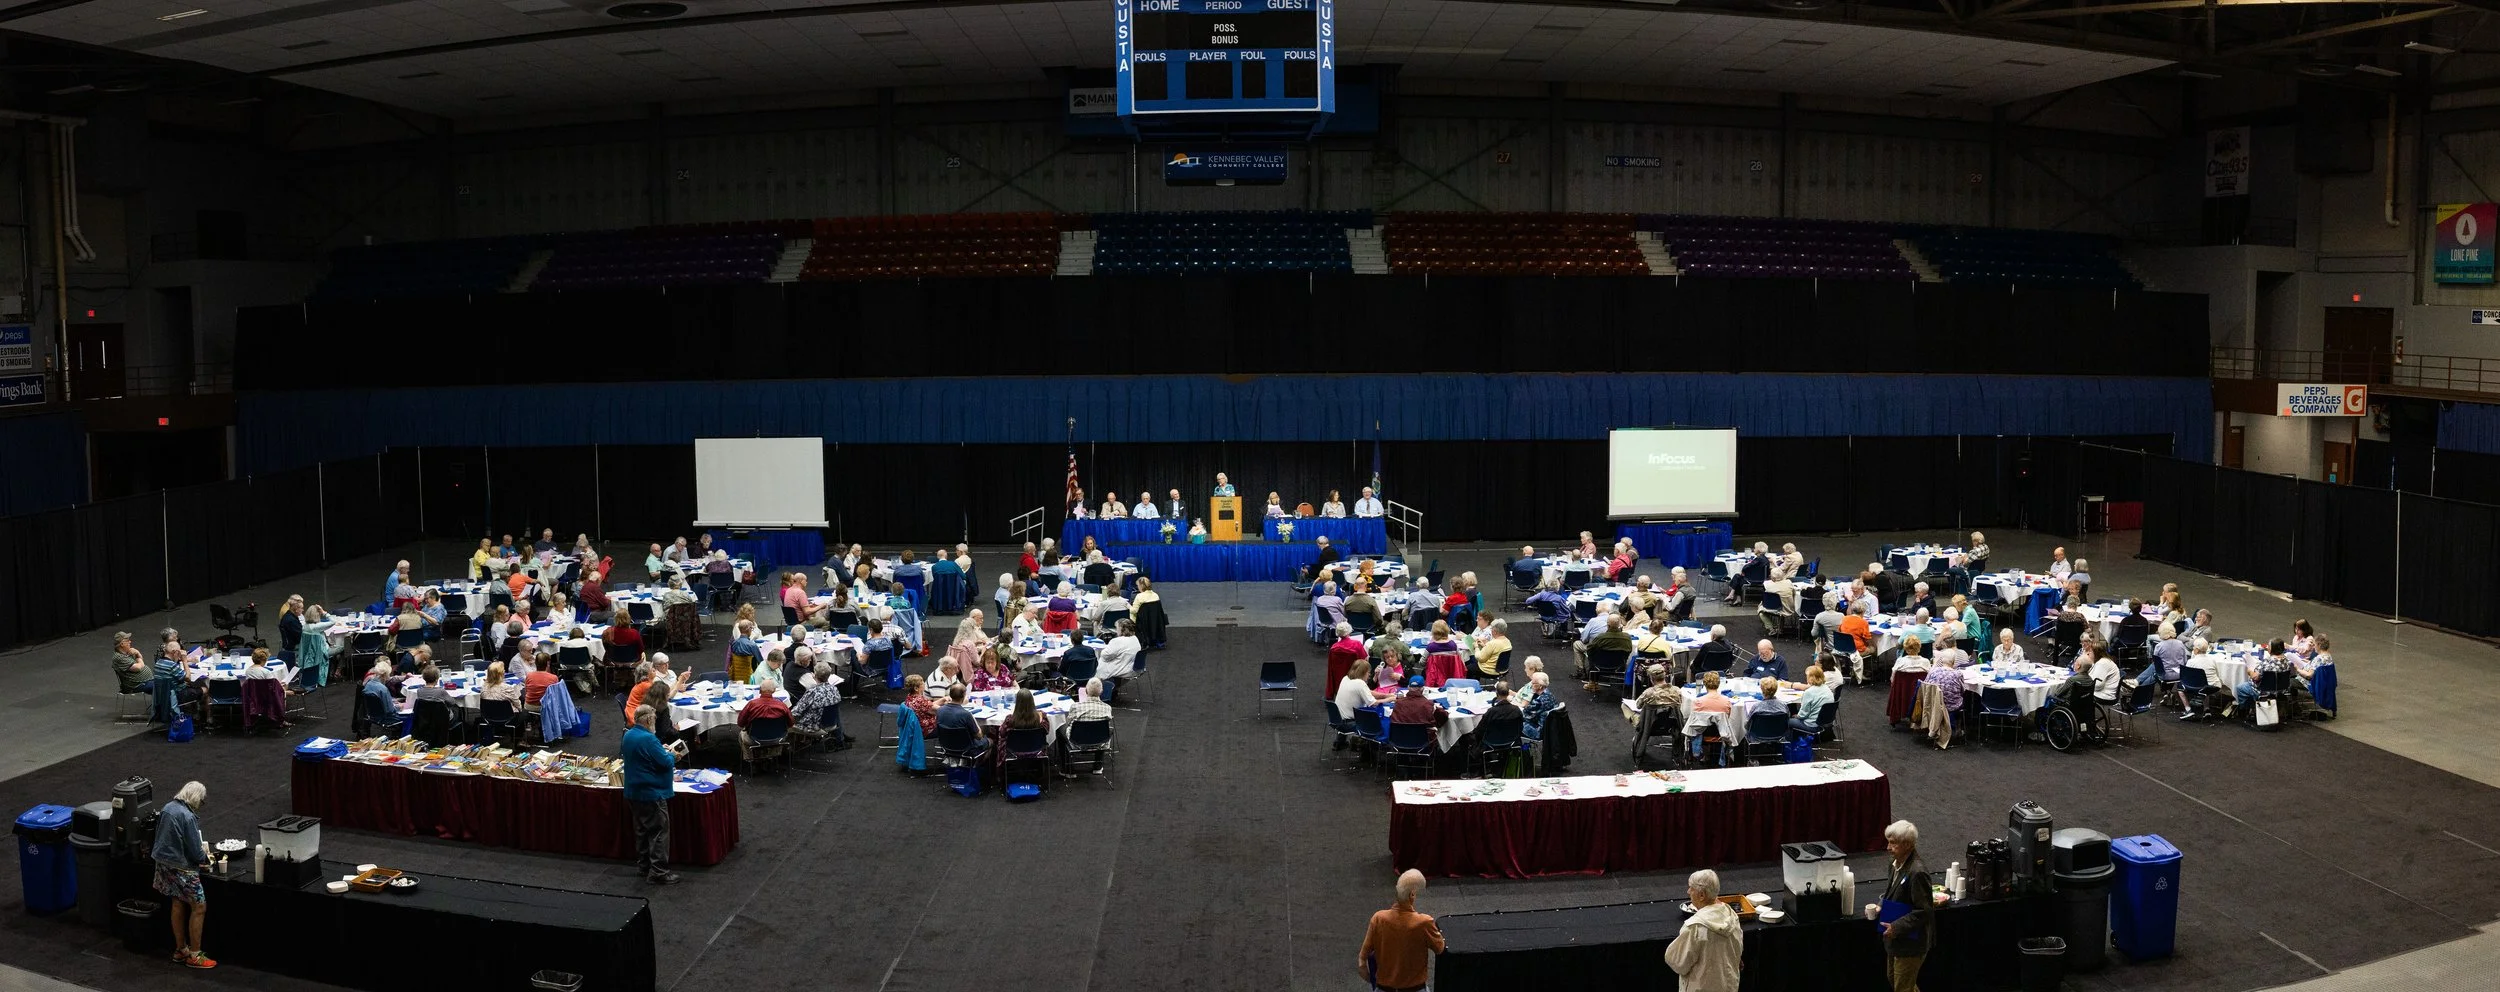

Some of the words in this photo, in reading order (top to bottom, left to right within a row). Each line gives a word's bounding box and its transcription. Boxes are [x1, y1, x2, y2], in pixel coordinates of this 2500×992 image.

[1140, 0, 1180, 11] HOME
[1205, 1, 1242, 10] PERIOD
[1267, 0, 1310, 9] GUEST
[1213, 23, 1238, 32] POSS.
[1211, 35, 1239, 44] BONUS
[1321, 0, 1332, 69] USTA
[1134, 52, 1167, 62] FOULS
[1189, 51, 1227, 61] PLAYER
[1240, 51, 1266, 60] FOUL
[1284, 50, 1316, 60] FOULS
[1087, 94, 1117, 104] MAIN
[946, 157, 961, 168] 25
[1208, 155, 1252, 163] KENNEBEC
[1253, 155, 1285, 163] VALLEY
[1606, 157, 1619, 166] NO
[1624, 157, 1661, 167] SMOKING
[1750, 161, 1763, 171] 28
[2450, 249, 2465, 261] LONE
[2465, 249, 2479, 262] PINE
[4, 331, 24, 341] pepsi
[6, 358, 31, 367] SMOKING
[20, 380, 43, 396] Bank
[2304, 386, 2329, 395] PEPSI
[2289, 395, 2342, 404] BEVERAGES
[2292, 405, 2339, 414] COMPANY
[1648, 453, 1696, 464] InFocus
